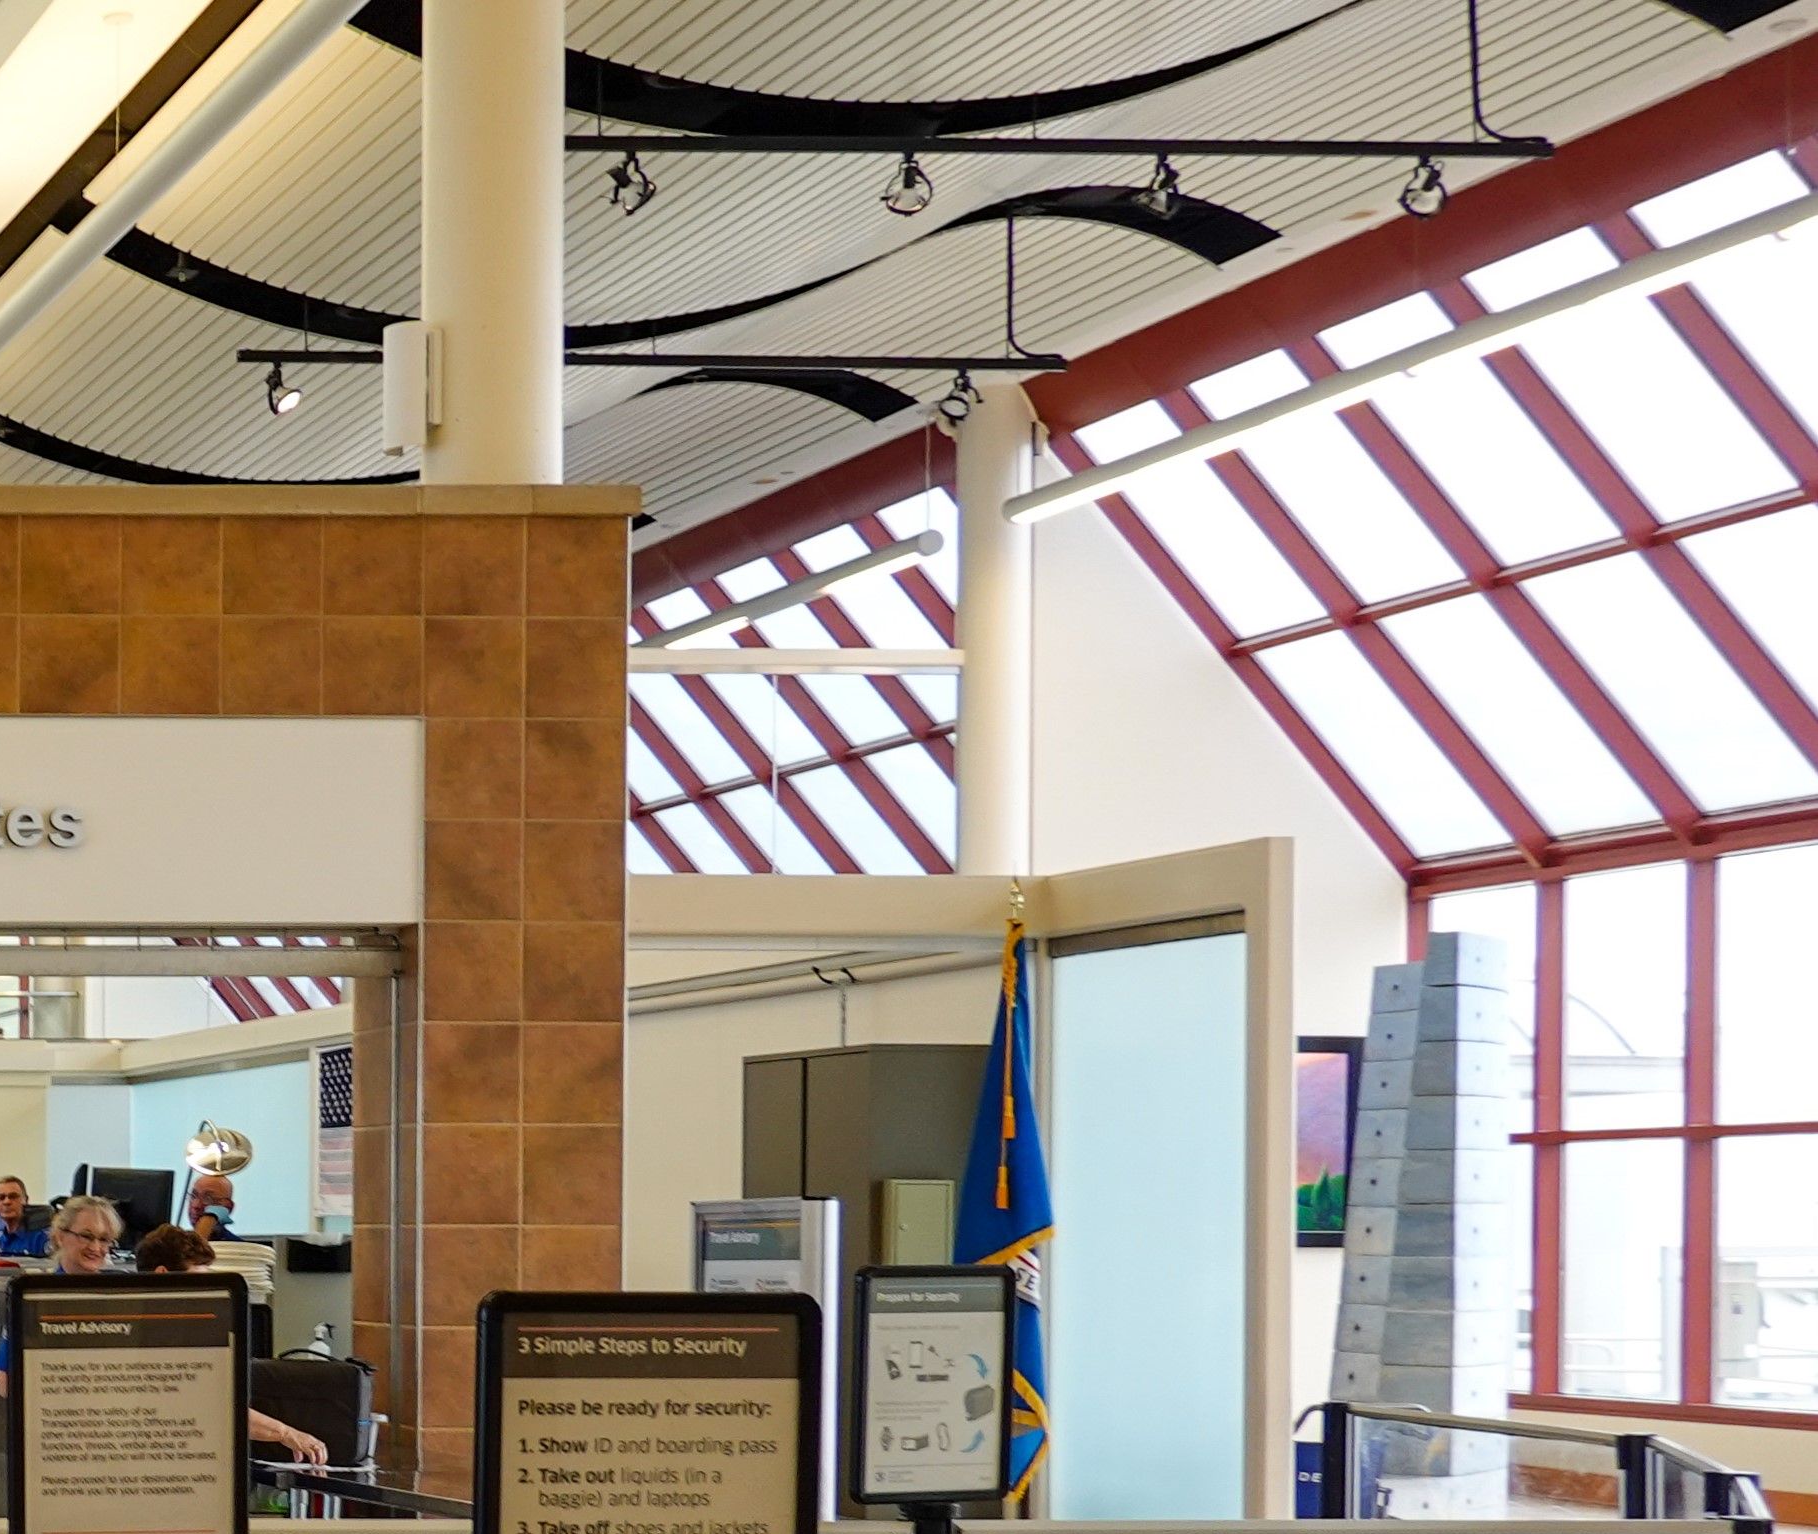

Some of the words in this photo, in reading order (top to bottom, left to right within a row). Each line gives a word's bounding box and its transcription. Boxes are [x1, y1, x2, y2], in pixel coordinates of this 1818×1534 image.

[40, 1322, 77, 1333] Travel
[78, 1322, 132, 1336] Advisory
[517, 1337, 530, 1353] 3
[534, 1337, 595, 1357] Simple
[598, 1337, 647, 1358] Steps
[650, 1337, 670, 1354] to
[673, 1337, 748, 1358] Security
[517, 1400, 576, 1414] Please
[580, 1400, 603, 1415] be
[607, 1400, 658, 1419] ready
[664, 1400, 688, 1415] for
[694, 1400, 772, 1419] security:
[518, 1438, 534, 1453] 1.
[537, 1438, 588, 1453] Show
[593, 1438, 612, 1453] ID
[618, 1438, 650, 1453] and
[655, 1438, 734, 1457] boarding
[738, 1442, 778, 1457] pass
[517, 1468, 533, 1483] 2.
[538, 1468, 581, 1483] Take
[584, 1468, 615, 1483] out
[620, 1468, 678, 1487] liquids
[684, 1468, 706, 1487] (in
[538, 1490, 602, 1510] baggie)
[608, 1490, 642, 1506] and
[646, 1490, 711, 1510] laptops
